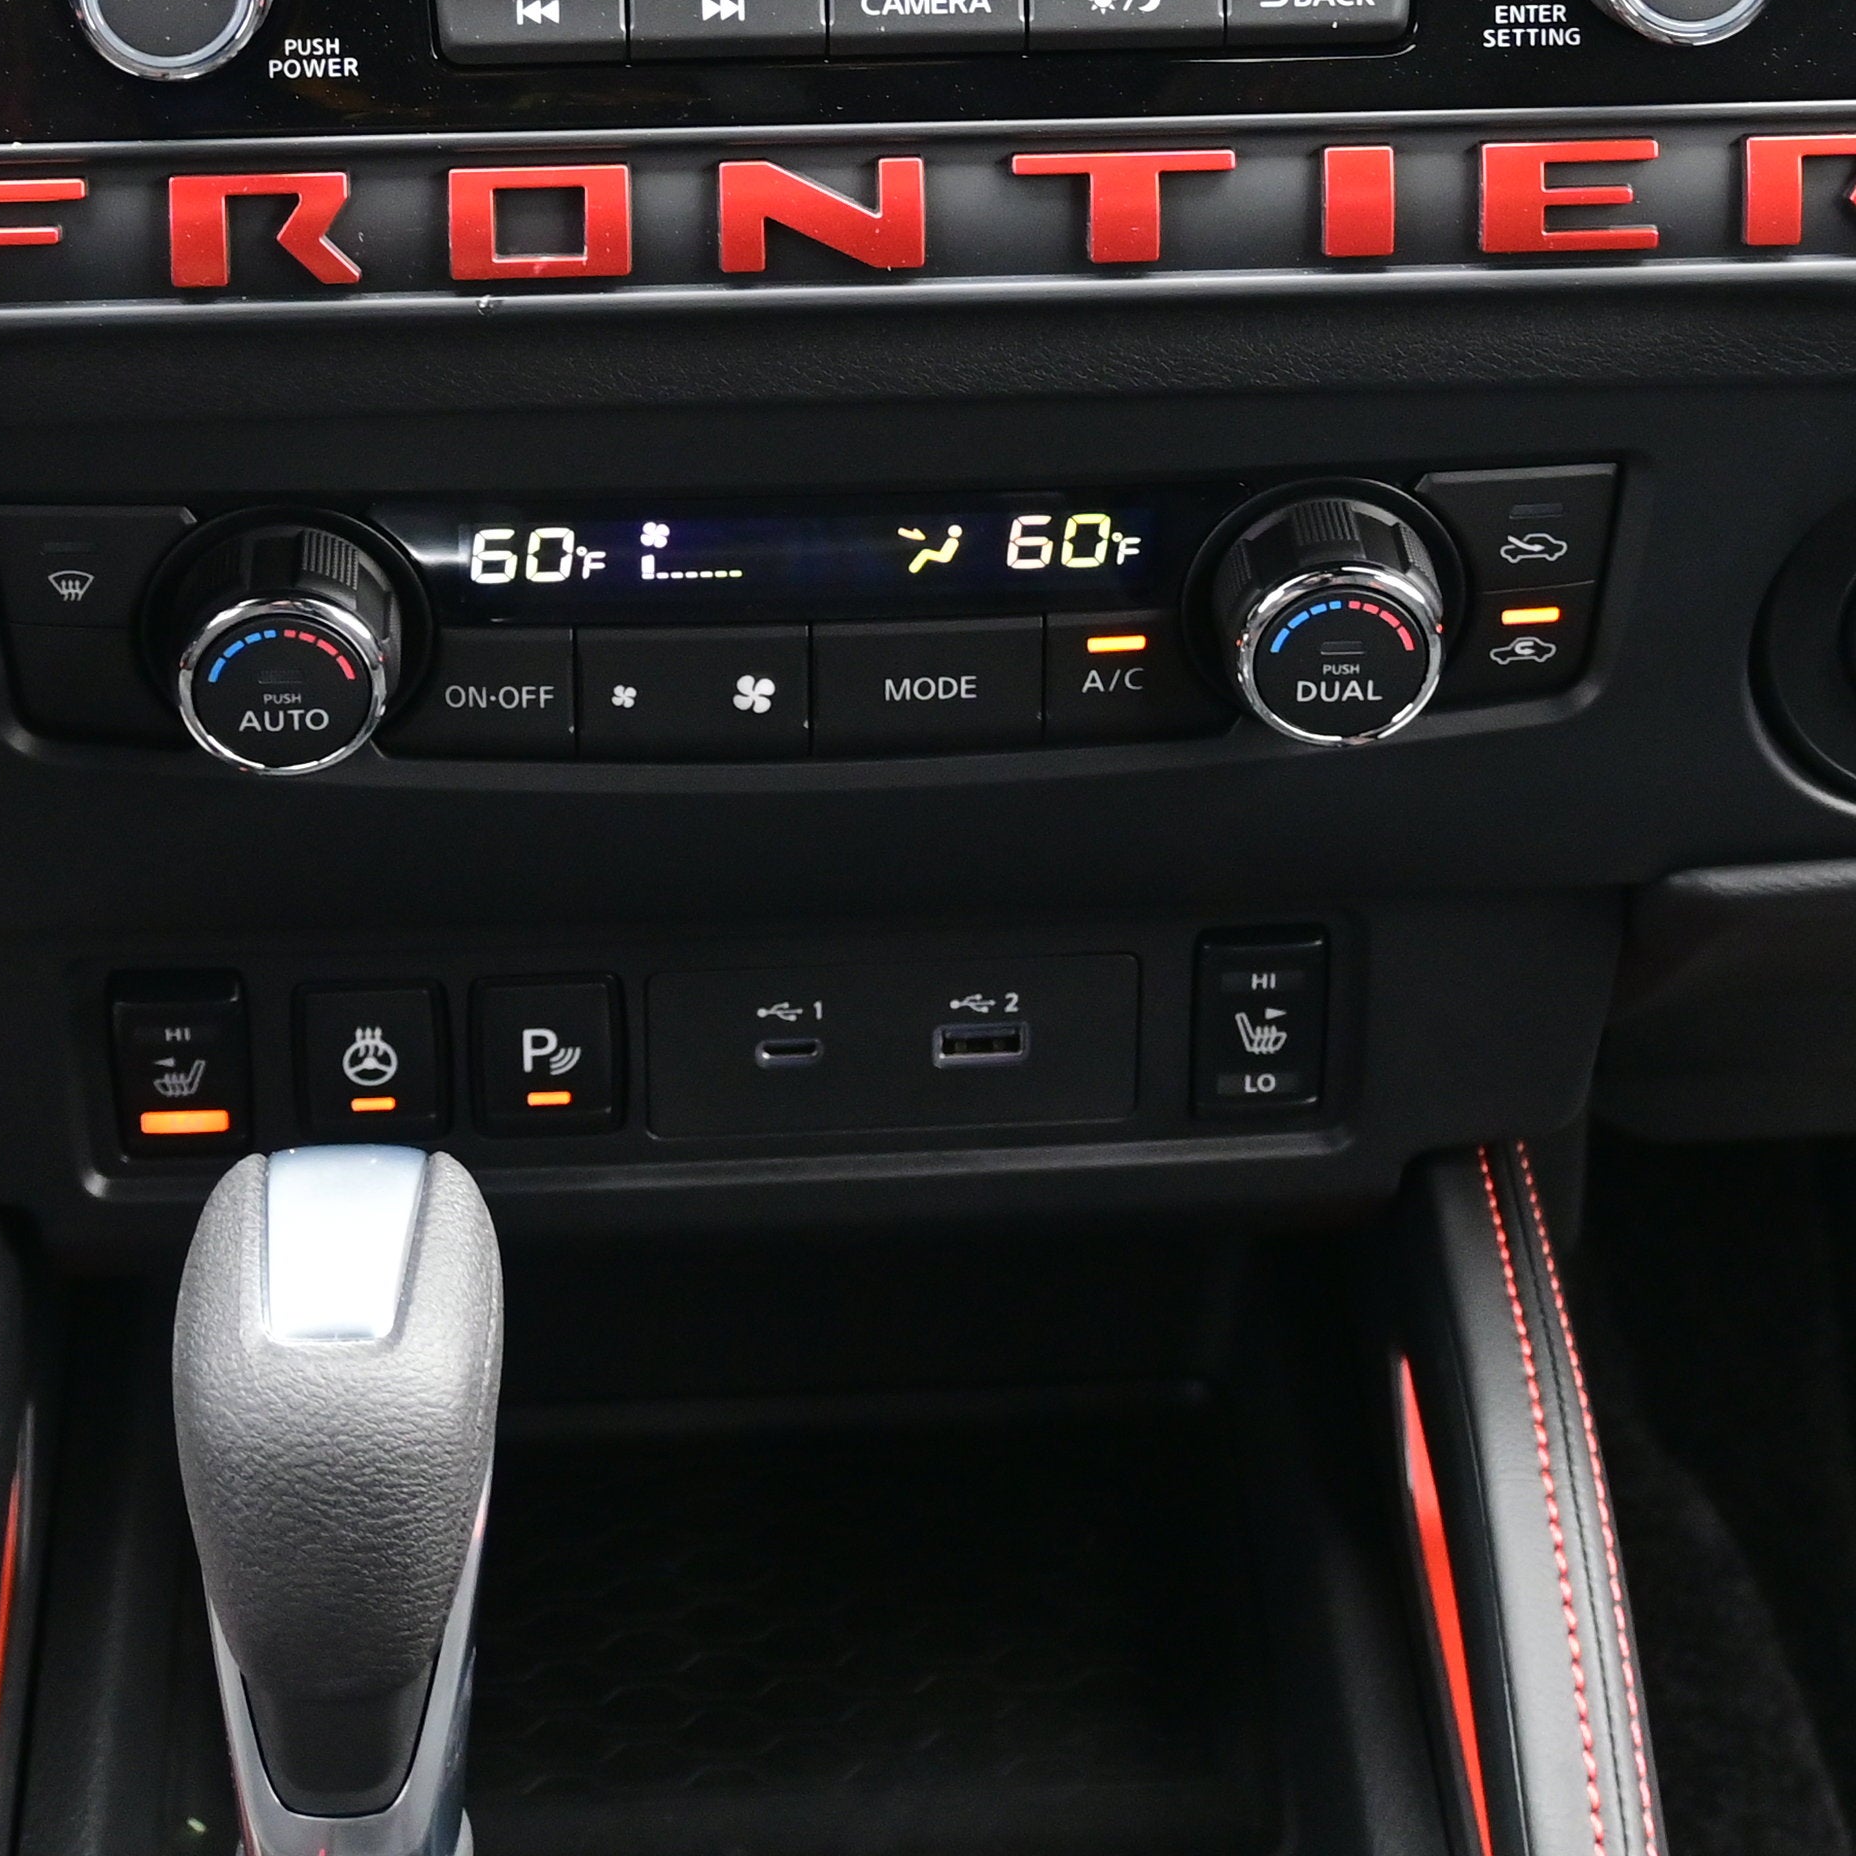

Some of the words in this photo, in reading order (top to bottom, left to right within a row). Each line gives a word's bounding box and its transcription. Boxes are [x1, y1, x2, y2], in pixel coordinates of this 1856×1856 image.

[1494, 4, 1567, 25] ENTER
[283, 37, 341, 56] PUSH
[1482, 26, 1581, 49] SETTING
[268, 56, 359, 80] POWER
[1321, 662, 1362, 676] PUSH
[883, 674, 978, 703] MODE
[1082, 666, 1145, 694] A/C
[262, 692, 302, 705] PUSH
[1295, 679, 1384, 704] DUAL
[238, 708, 330, 733] AUTO
[1251, 973, 1277, 991] HI
[812, 1001, 824, 1020] 1
[1003, 992, 1020, 1014] 2
[164, 1026, 191, 1042] HI
[1244, 1074, 1277, 1094] LO
